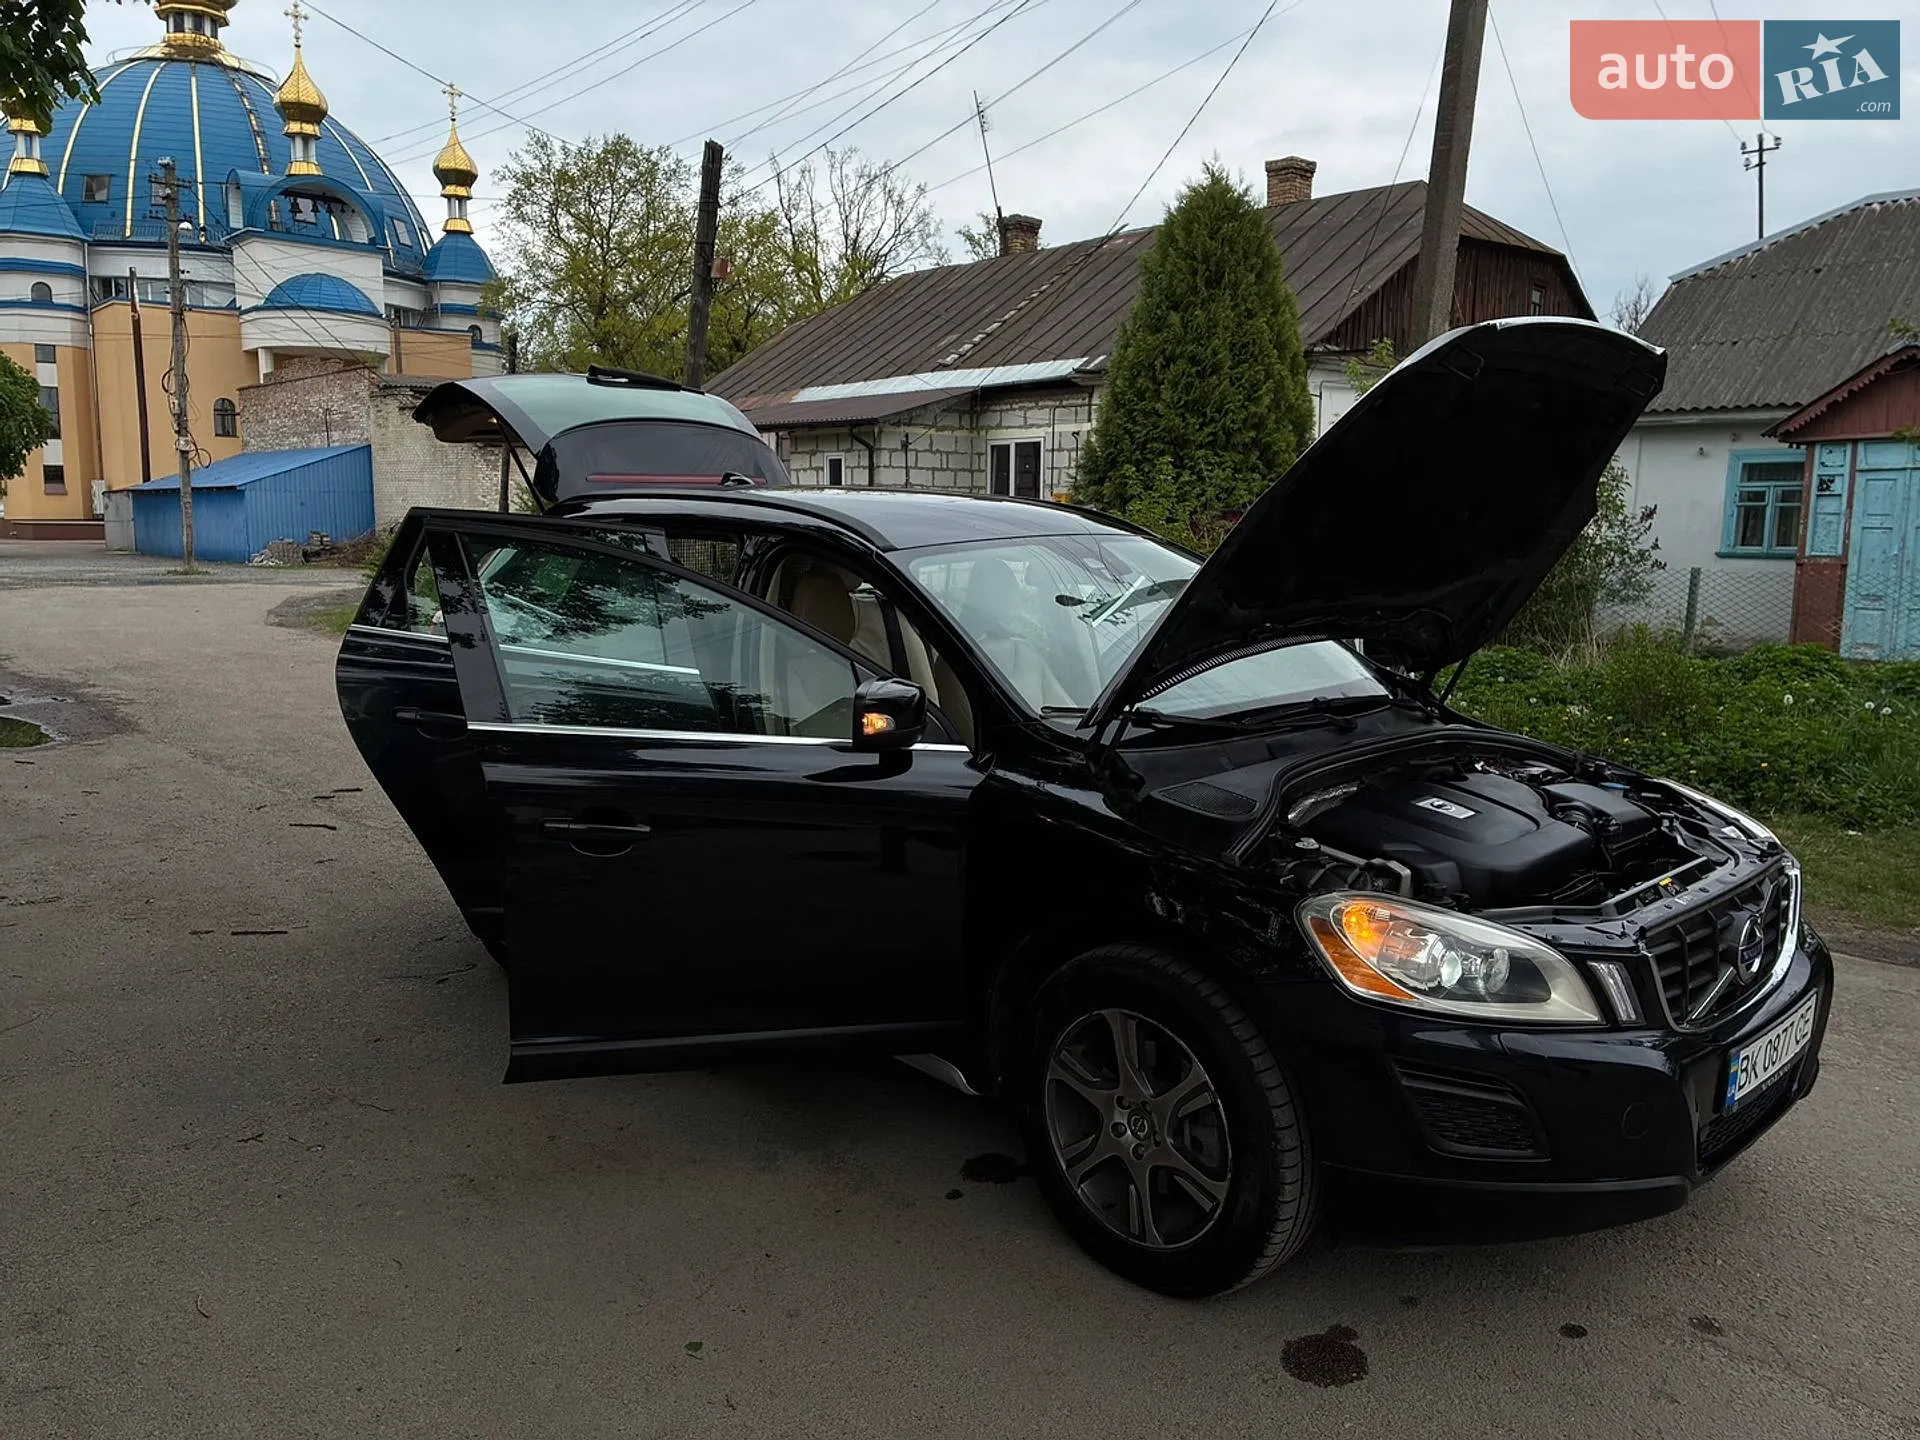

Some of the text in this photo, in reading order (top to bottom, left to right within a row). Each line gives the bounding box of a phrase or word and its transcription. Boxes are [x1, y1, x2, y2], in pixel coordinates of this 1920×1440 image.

[1739, 1005, 1812, 1092] BK 0877 CE
